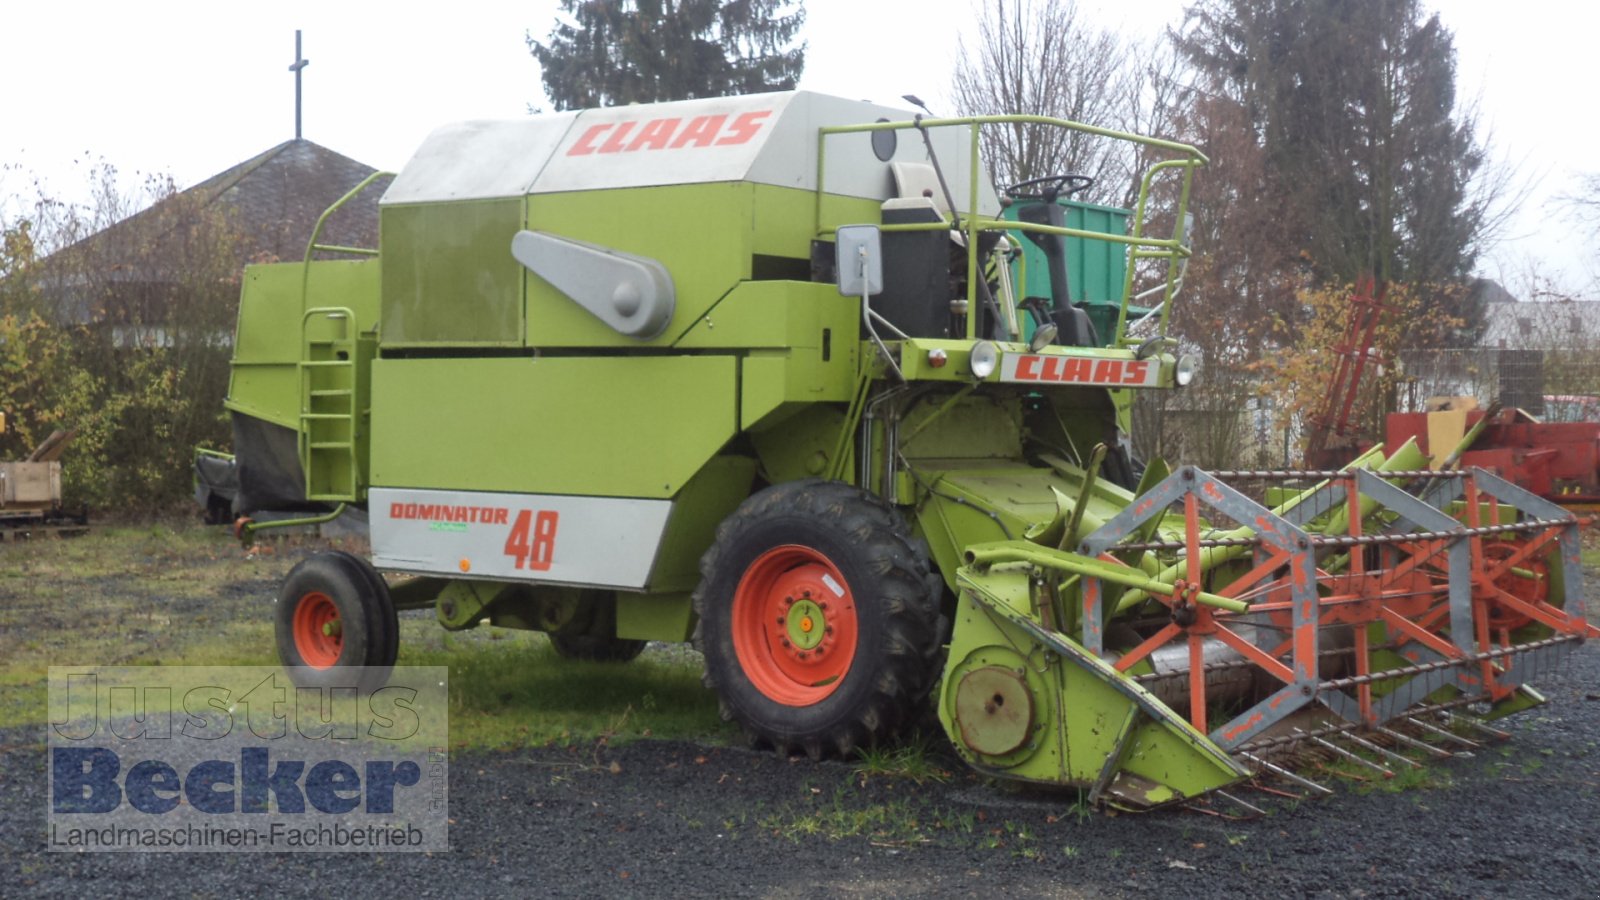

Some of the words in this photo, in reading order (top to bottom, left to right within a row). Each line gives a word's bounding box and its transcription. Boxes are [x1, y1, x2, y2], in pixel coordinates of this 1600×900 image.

[566, 110, 773, 156] CLAAS
[1014, 355, 1148, 385] CLAAS
[390, 502, 509, 525] DOMINATOR
[504, 509, 560, 572] 48
